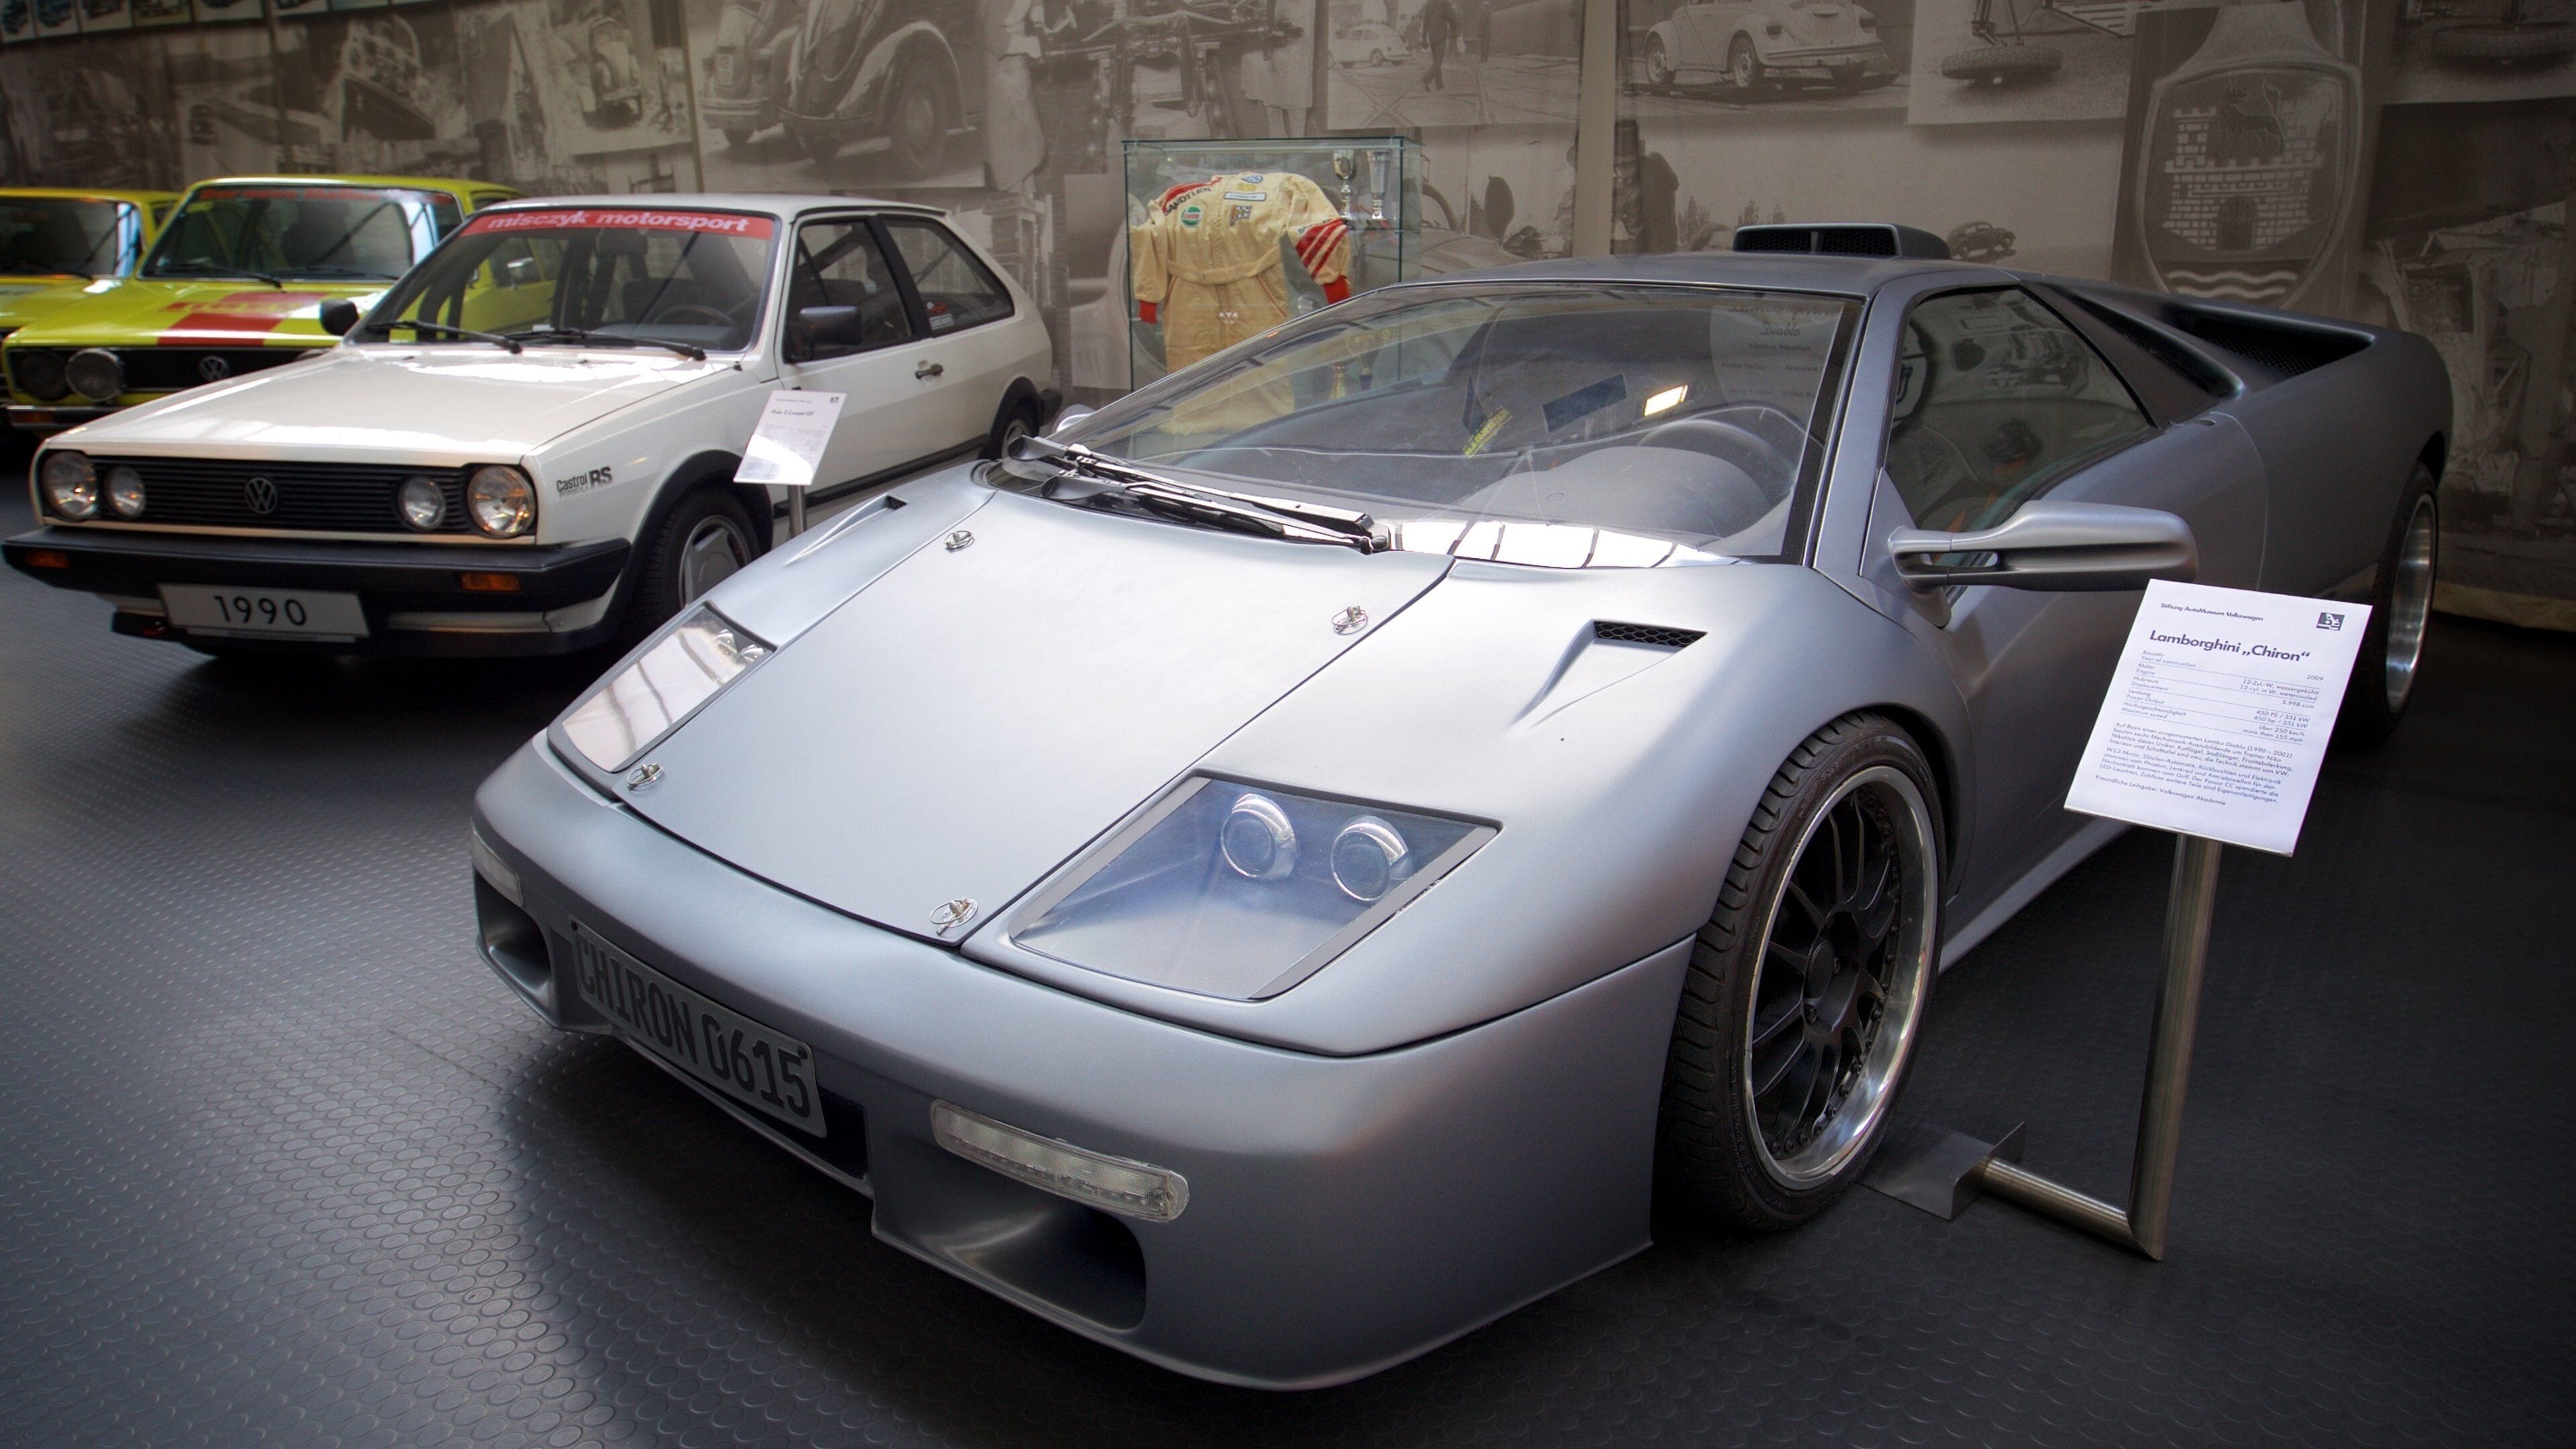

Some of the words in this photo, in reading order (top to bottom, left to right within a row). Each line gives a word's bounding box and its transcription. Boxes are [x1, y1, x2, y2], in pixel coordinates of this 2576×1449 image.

[596, 212, 750, 232] motorsport
[556, 473, 588, 492] Castrol
[589, 466, 612, 489] RS
[214, 595, 307, 626] 1990
[2161, 602, 2183, 611] Stiftung
[2184, 606, 2224, 616] AutoMuseum
[2226, 611, 2263, 621] Volkswagen
[2149, 630, 2241, 653] Lamborghini
[2163, 659, 2196, 667] construction
[2131, 682, 2168, 692] Displacement
[2133, 676, 2159, 684] Hubraum
[2128, 689, 2151, 697] Leistung
[2145, 697, 2165, 705] Output
[2279, 690, 2317, 701] watercooled
[2121, 707, 2149, 716] Maximum
[2158, 730, 2203, 742] ausgemusterten
[2226, 742, 2246, 750] Diablo
[2273, 751, 2292, 759] 2001)
[2104, 753, 2129, 761] stammen
[2169, 765, 2194, 774] Lenkrad
[2109, 739, 2133, 747] Interieur
[2215, 758, 2238, 767] Technik
[2239, 763, 2261, 771] stammt
[2243, 751, 2265, 759] Trainer
[2102, 758, 2135, 769] Heckantrieb
[2137, 765, 2161, 774] kommen
[2204, 778, 2223, 786] Passat
[2235, 785, 2267, 796] spendierte
[2141, 771, 2164, 781] Zahllose
[2165, 777, 2186, 786] weitere
[2251, 775, 2282, 785] Elektronik
[2096, 775, 2128, 786] Freundliche
[2159, 788, 2194, 799] Volkswagen
[2196, 796, 2226, 806] Akademie
[574, 932, 698, 1065] CHIRON
[702, 1014, 810, 1118] 0615
